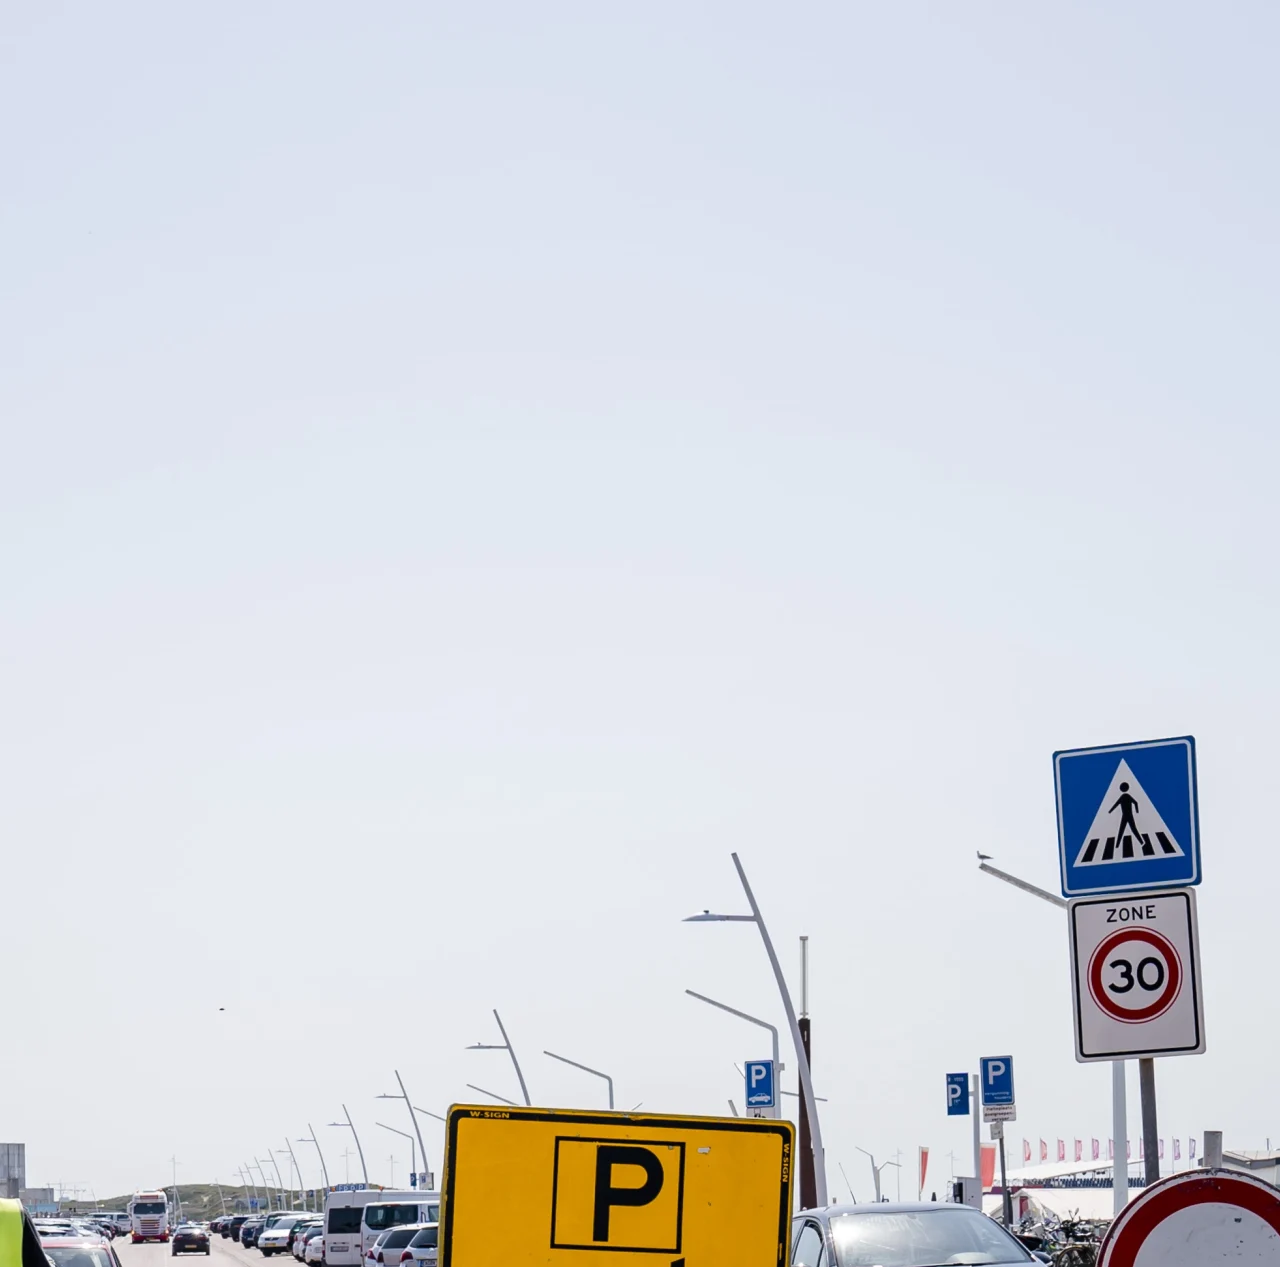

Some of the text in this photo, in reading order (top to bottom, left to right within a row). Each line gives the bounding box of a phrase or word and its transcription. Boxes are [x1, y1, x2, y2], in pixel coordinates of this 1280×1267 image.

[1106, 905, 1157, 923] ZONE
[1108, 957, 1165, 994] 30
[751, 1064, 767, 1088] P
[988, 1060, 1006, 1085] P
[947, 1084, 962, 1107] P
[469, 1110, 510, 1119] W-SIGN
[782, 1143, 790, 1183] W-SIGN
[592, 1144, 665, 1243] P
